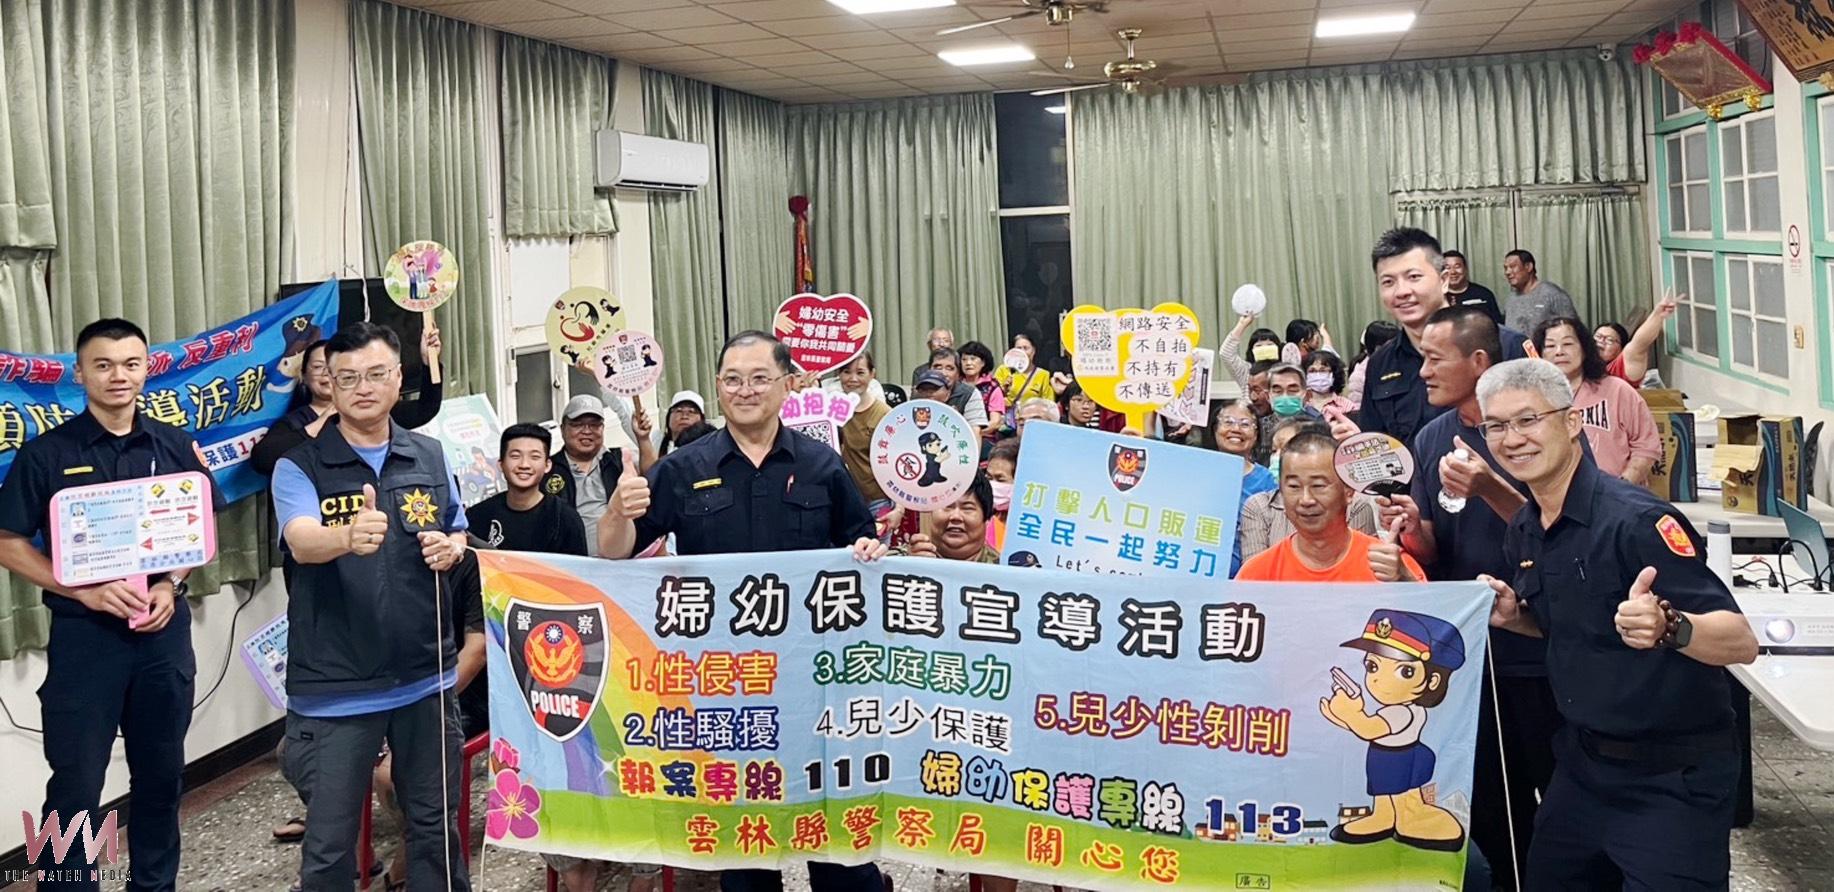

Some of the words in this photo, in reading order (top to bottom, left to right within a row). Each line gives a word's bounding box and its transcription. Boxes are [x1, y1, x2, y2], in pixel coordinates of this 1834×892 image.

[799, 306, 849, 323] 婦幼安全
[1118, 315, 1191, 331] 網路安全
[1127, 360, 1178, 377] 不持有
[1135, 338, 1187, 354] 不自拍
[1119, 382, 1173, 399] 不傳送
[320, 494, 365, 516] CID
[1022, 482, 1224, 546] 打擊人口販運
[1017, 512, 1218, 578] 全民一起努力
[516, 611, 533, 631] 警
[577, 614, 594, 636] 察
[658, 573, 1267, 659] 婦幼保護宣導活動
[626, 651, 778, 697] 1.性侵害
[813, 642, 1012, 701] 3.家庭暴力
[531, 689, 581, 720] POLICE
[816, 697, 1011, 754] 4.兒少保護
[1035, 692, 1291, 757] 5.兒少性剝削
[624, 706, 780, 752] 2.性騷擾
[618, 757, 785, 801] 報案專線
[803, 753, 891, 792] 110
[920, 749, 1186, 837] 婦幼保護專線
[1203, 797, 1303, 838] 113
[685, 805, 985, 858] 雲林縣警察局
[1026, 823, 1181, 885] 關心您
[1239, 875, 1268, 887] 廣告
